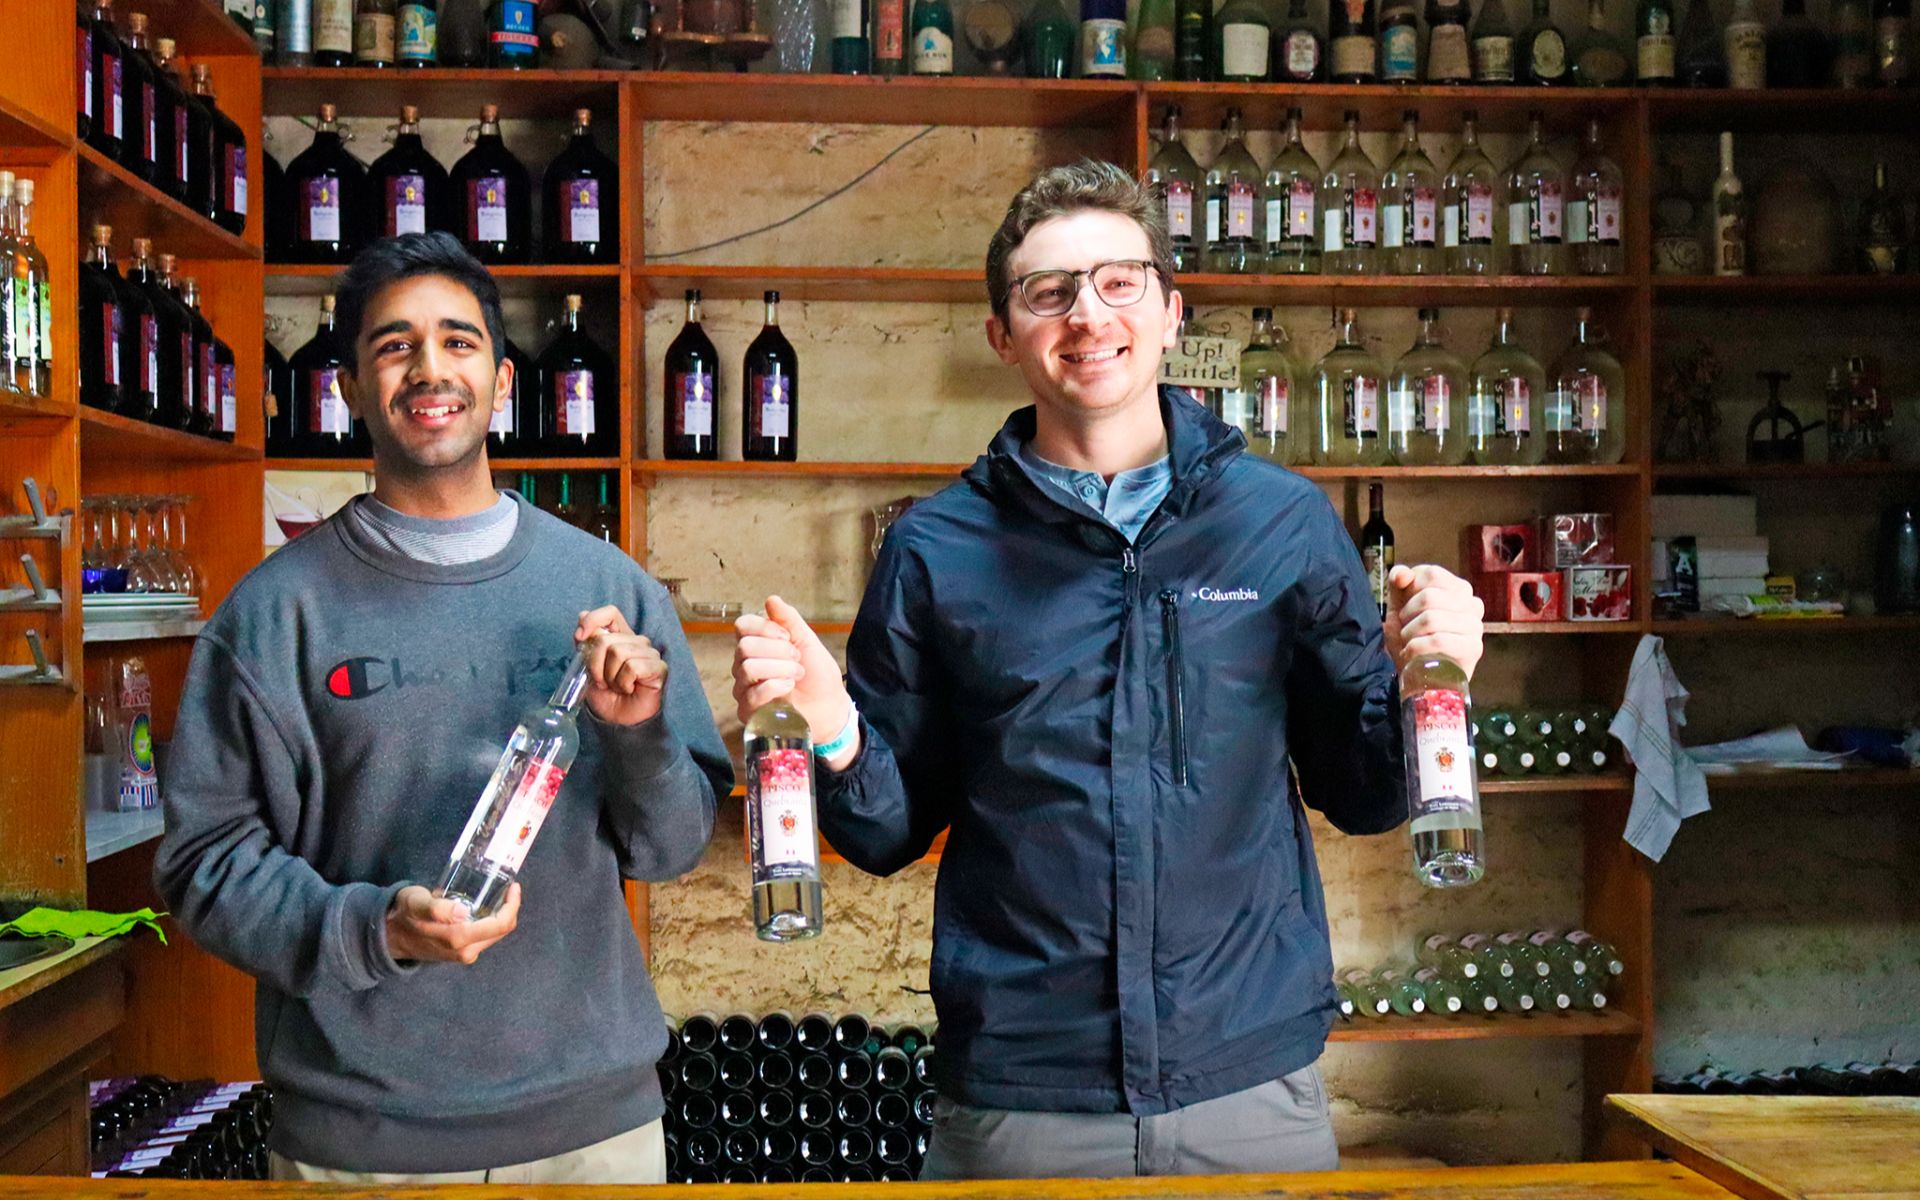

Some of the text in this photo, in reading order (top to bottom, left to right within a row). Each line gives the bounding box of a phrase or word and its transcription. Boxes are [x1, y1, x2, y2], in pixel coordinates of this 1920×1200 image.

[1181, 341, 1223, 363] Up!
[1164, 362, 1237, 381] Little!
[1198, 587, 1259, 601] Columbia
[325, 656, 572, 700] Chap
[1423, 721, 1457, 731] PISCO
[768, 783, 801, 793] PISCO
